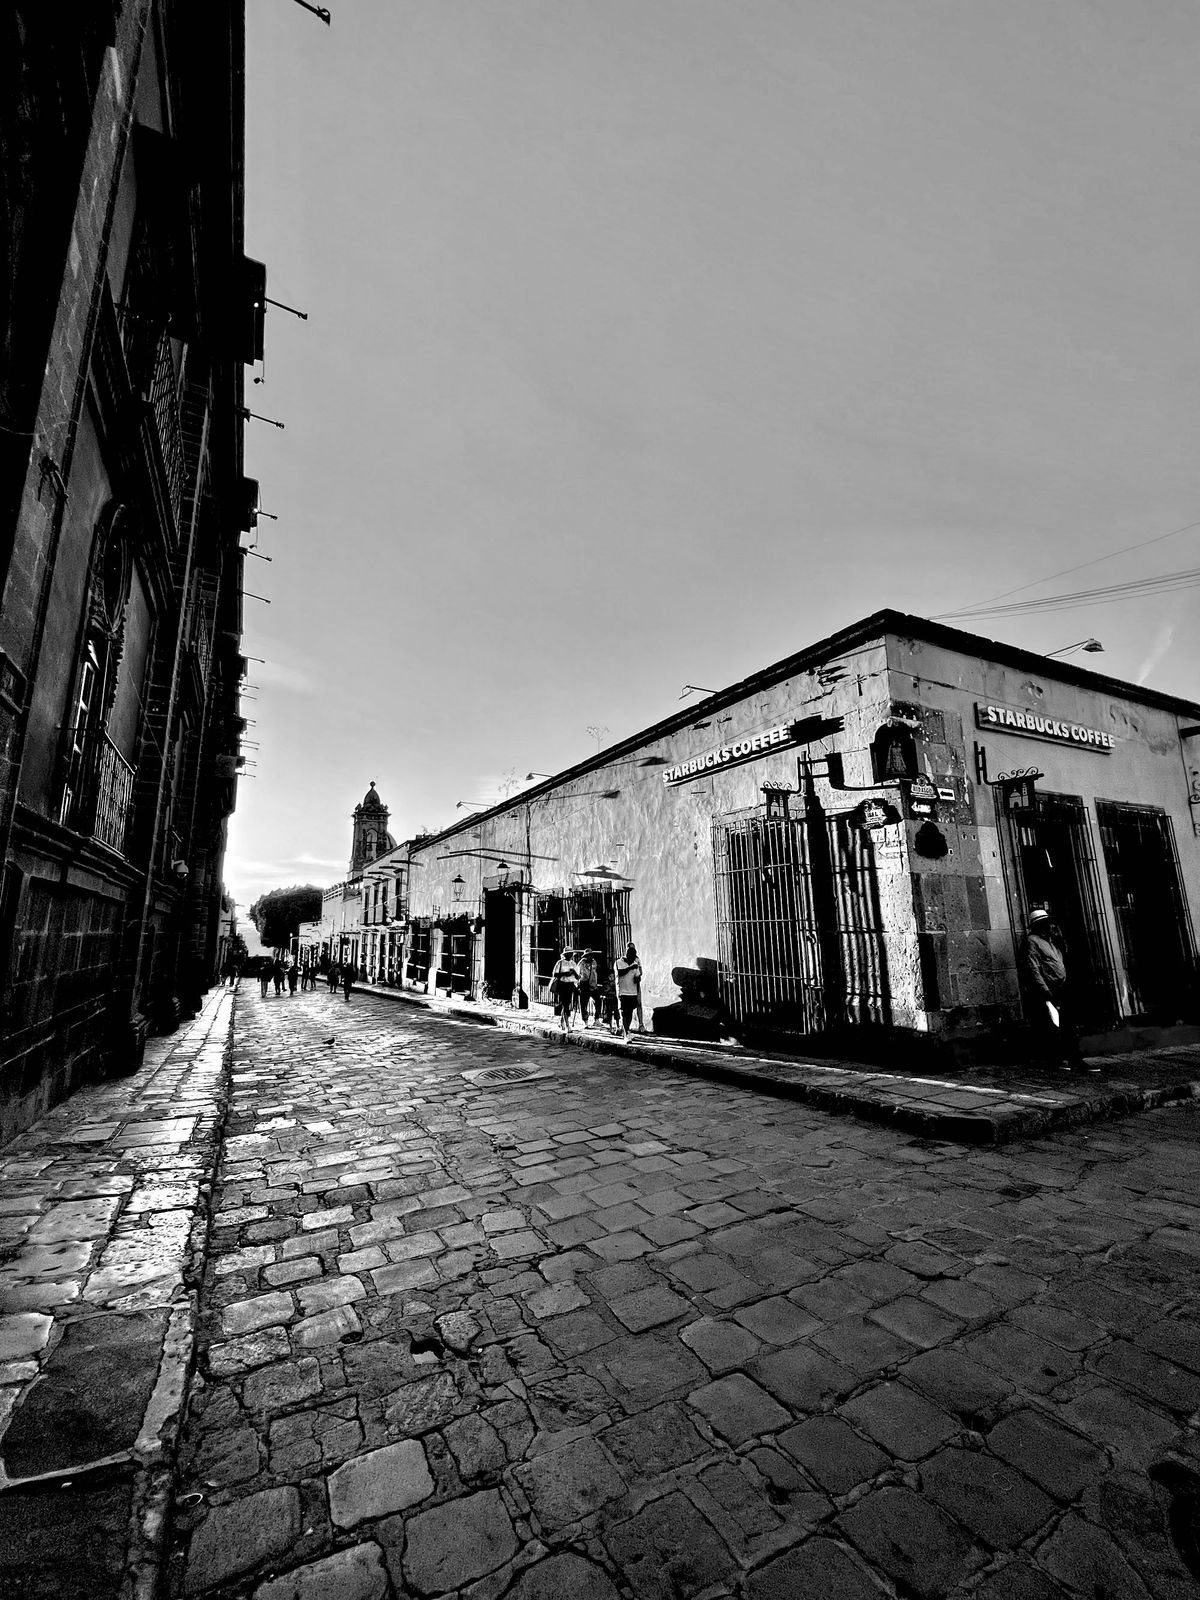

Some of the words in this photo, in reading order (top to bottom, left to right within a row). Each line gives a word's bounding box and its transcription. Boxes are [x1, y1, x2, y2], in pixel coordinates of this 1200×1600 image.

[987, 705, 1069, 738] STARBUCKS
[1071, 725, 1115, 748] COFFEE
[662, 748, 729, 783] STARBUCKS
[732, 725, 789, 757] COFFEE
